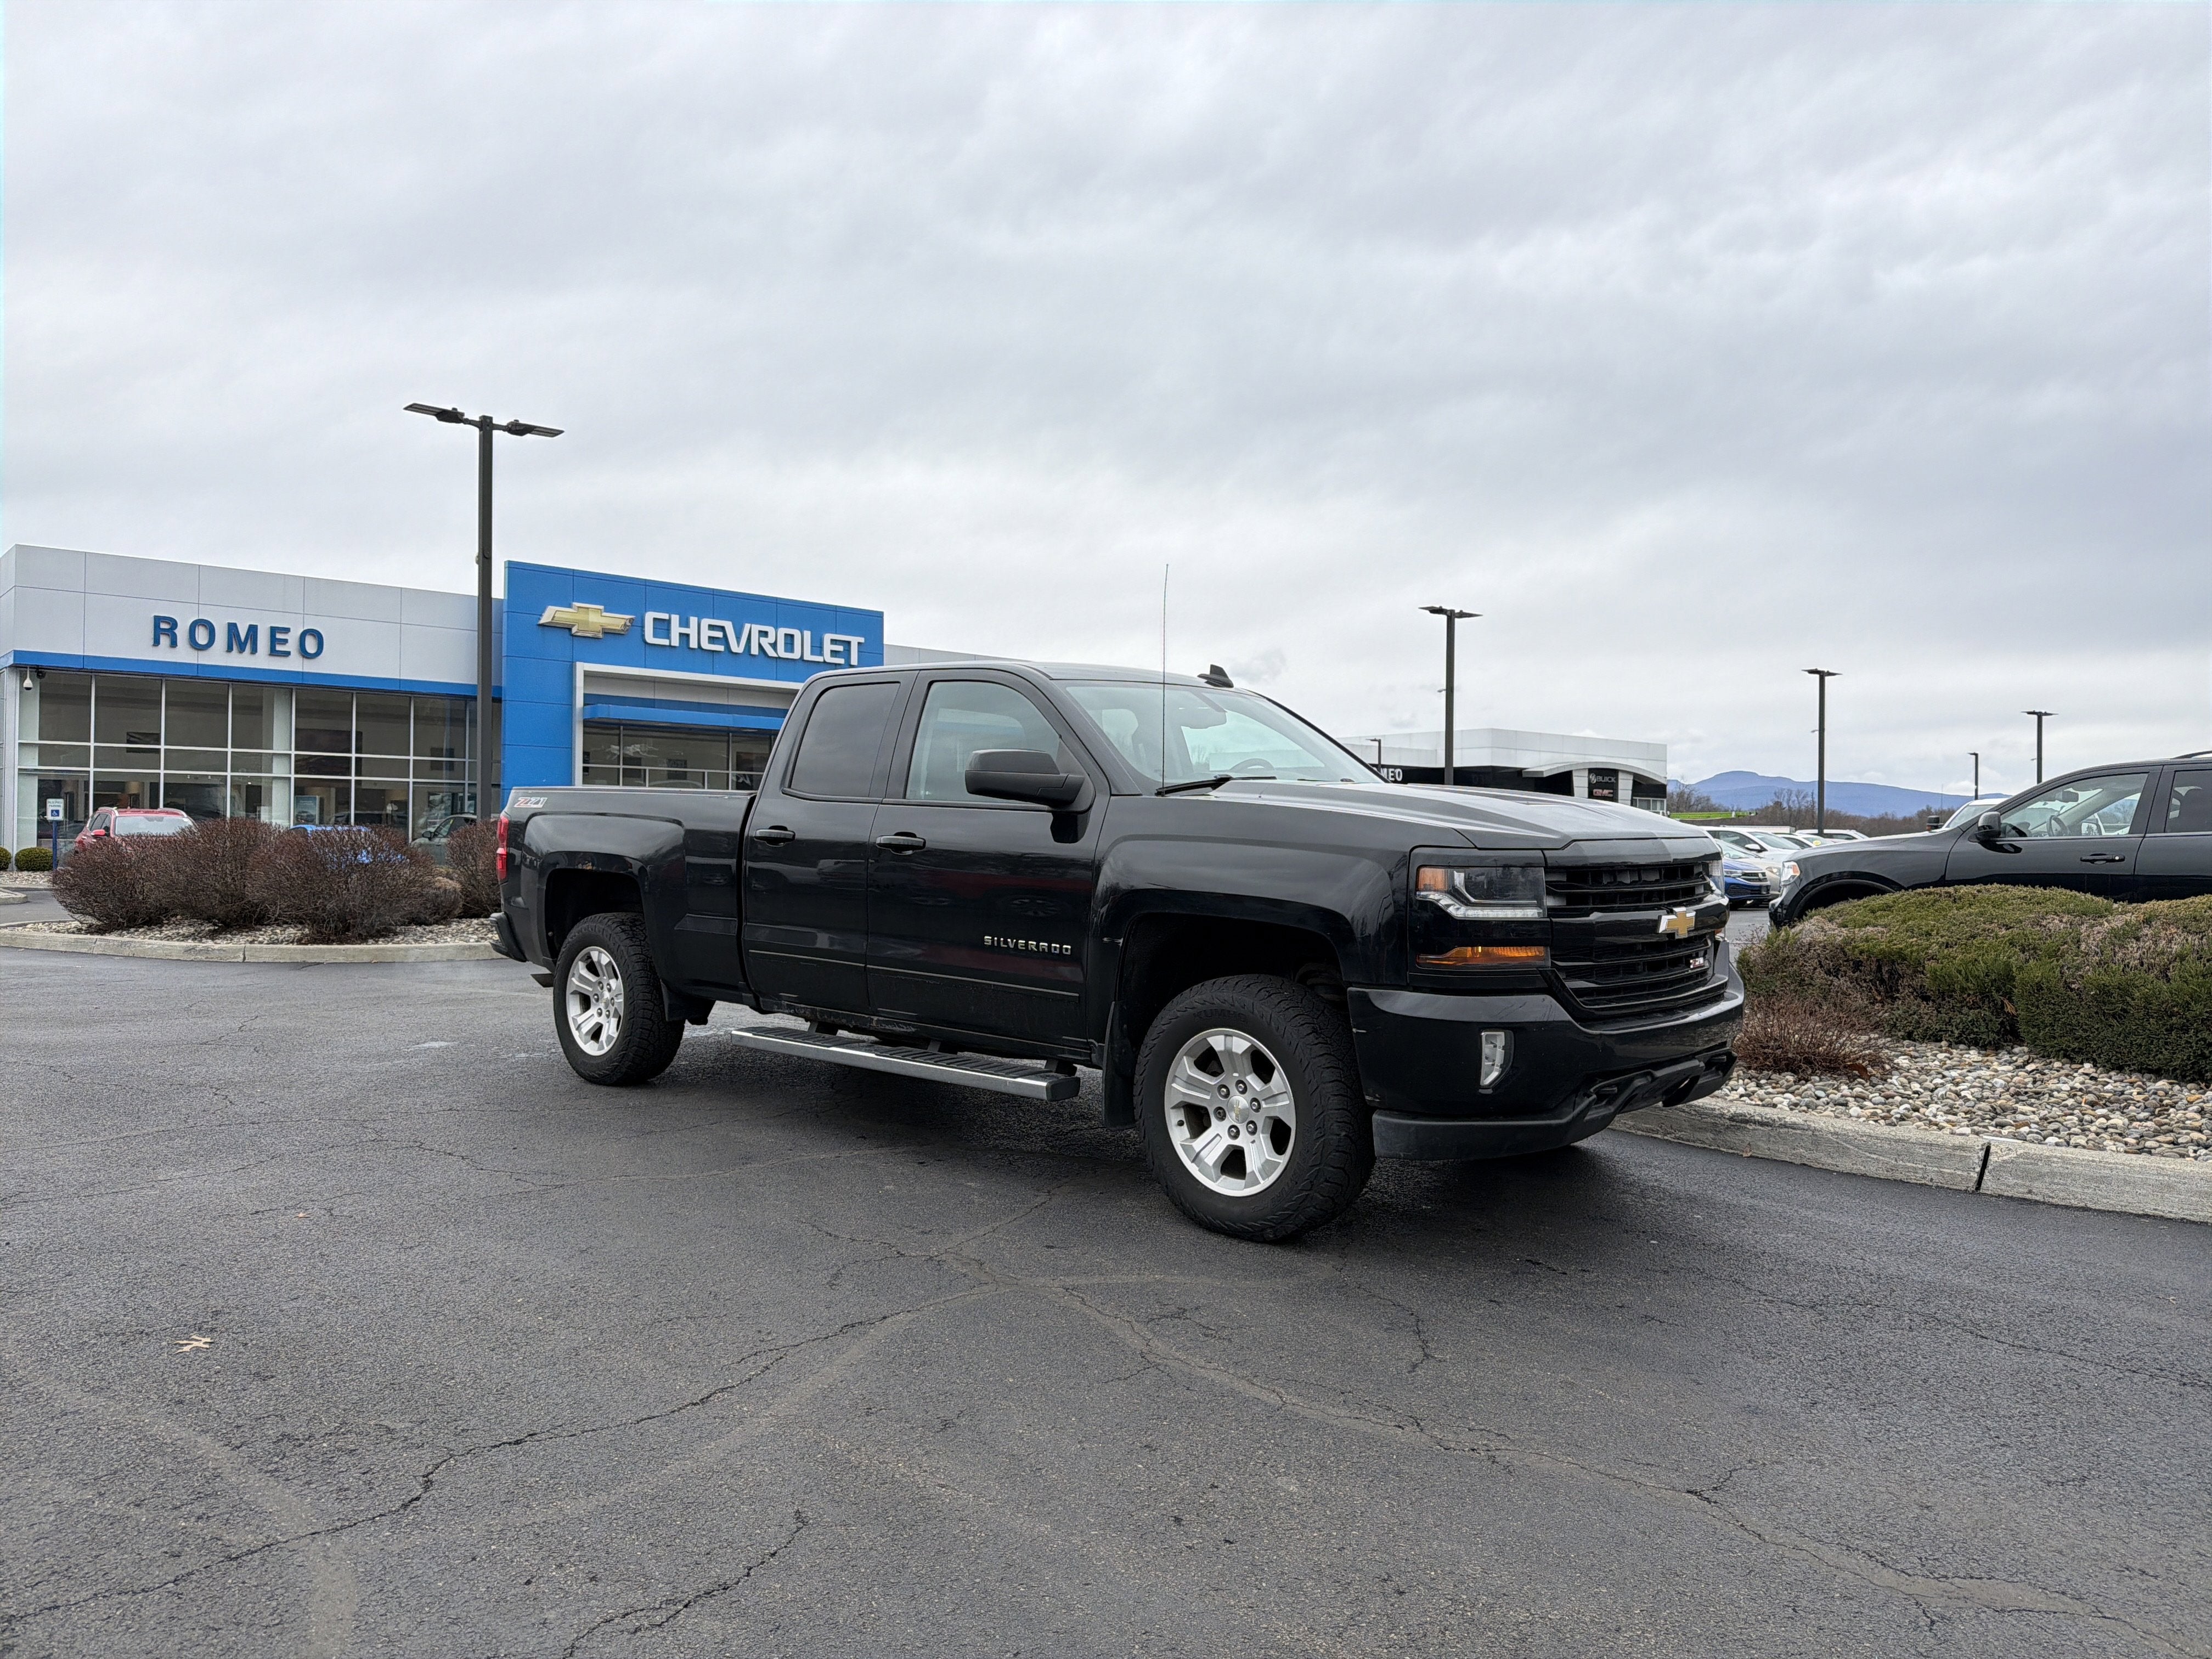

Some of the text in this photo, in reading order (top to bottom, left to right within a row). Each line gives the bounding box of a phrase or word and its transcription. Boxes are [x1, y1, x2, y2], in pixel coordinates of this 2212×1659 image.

[153, 615, 324, 659] ROMEO
[645, 611, 865, 665] CHEVROLET
[1372, 767, 1403, 781] MEO
[514, 797, 548, 808] Z71
[984, 935, 1071, 955] SILVERADO
